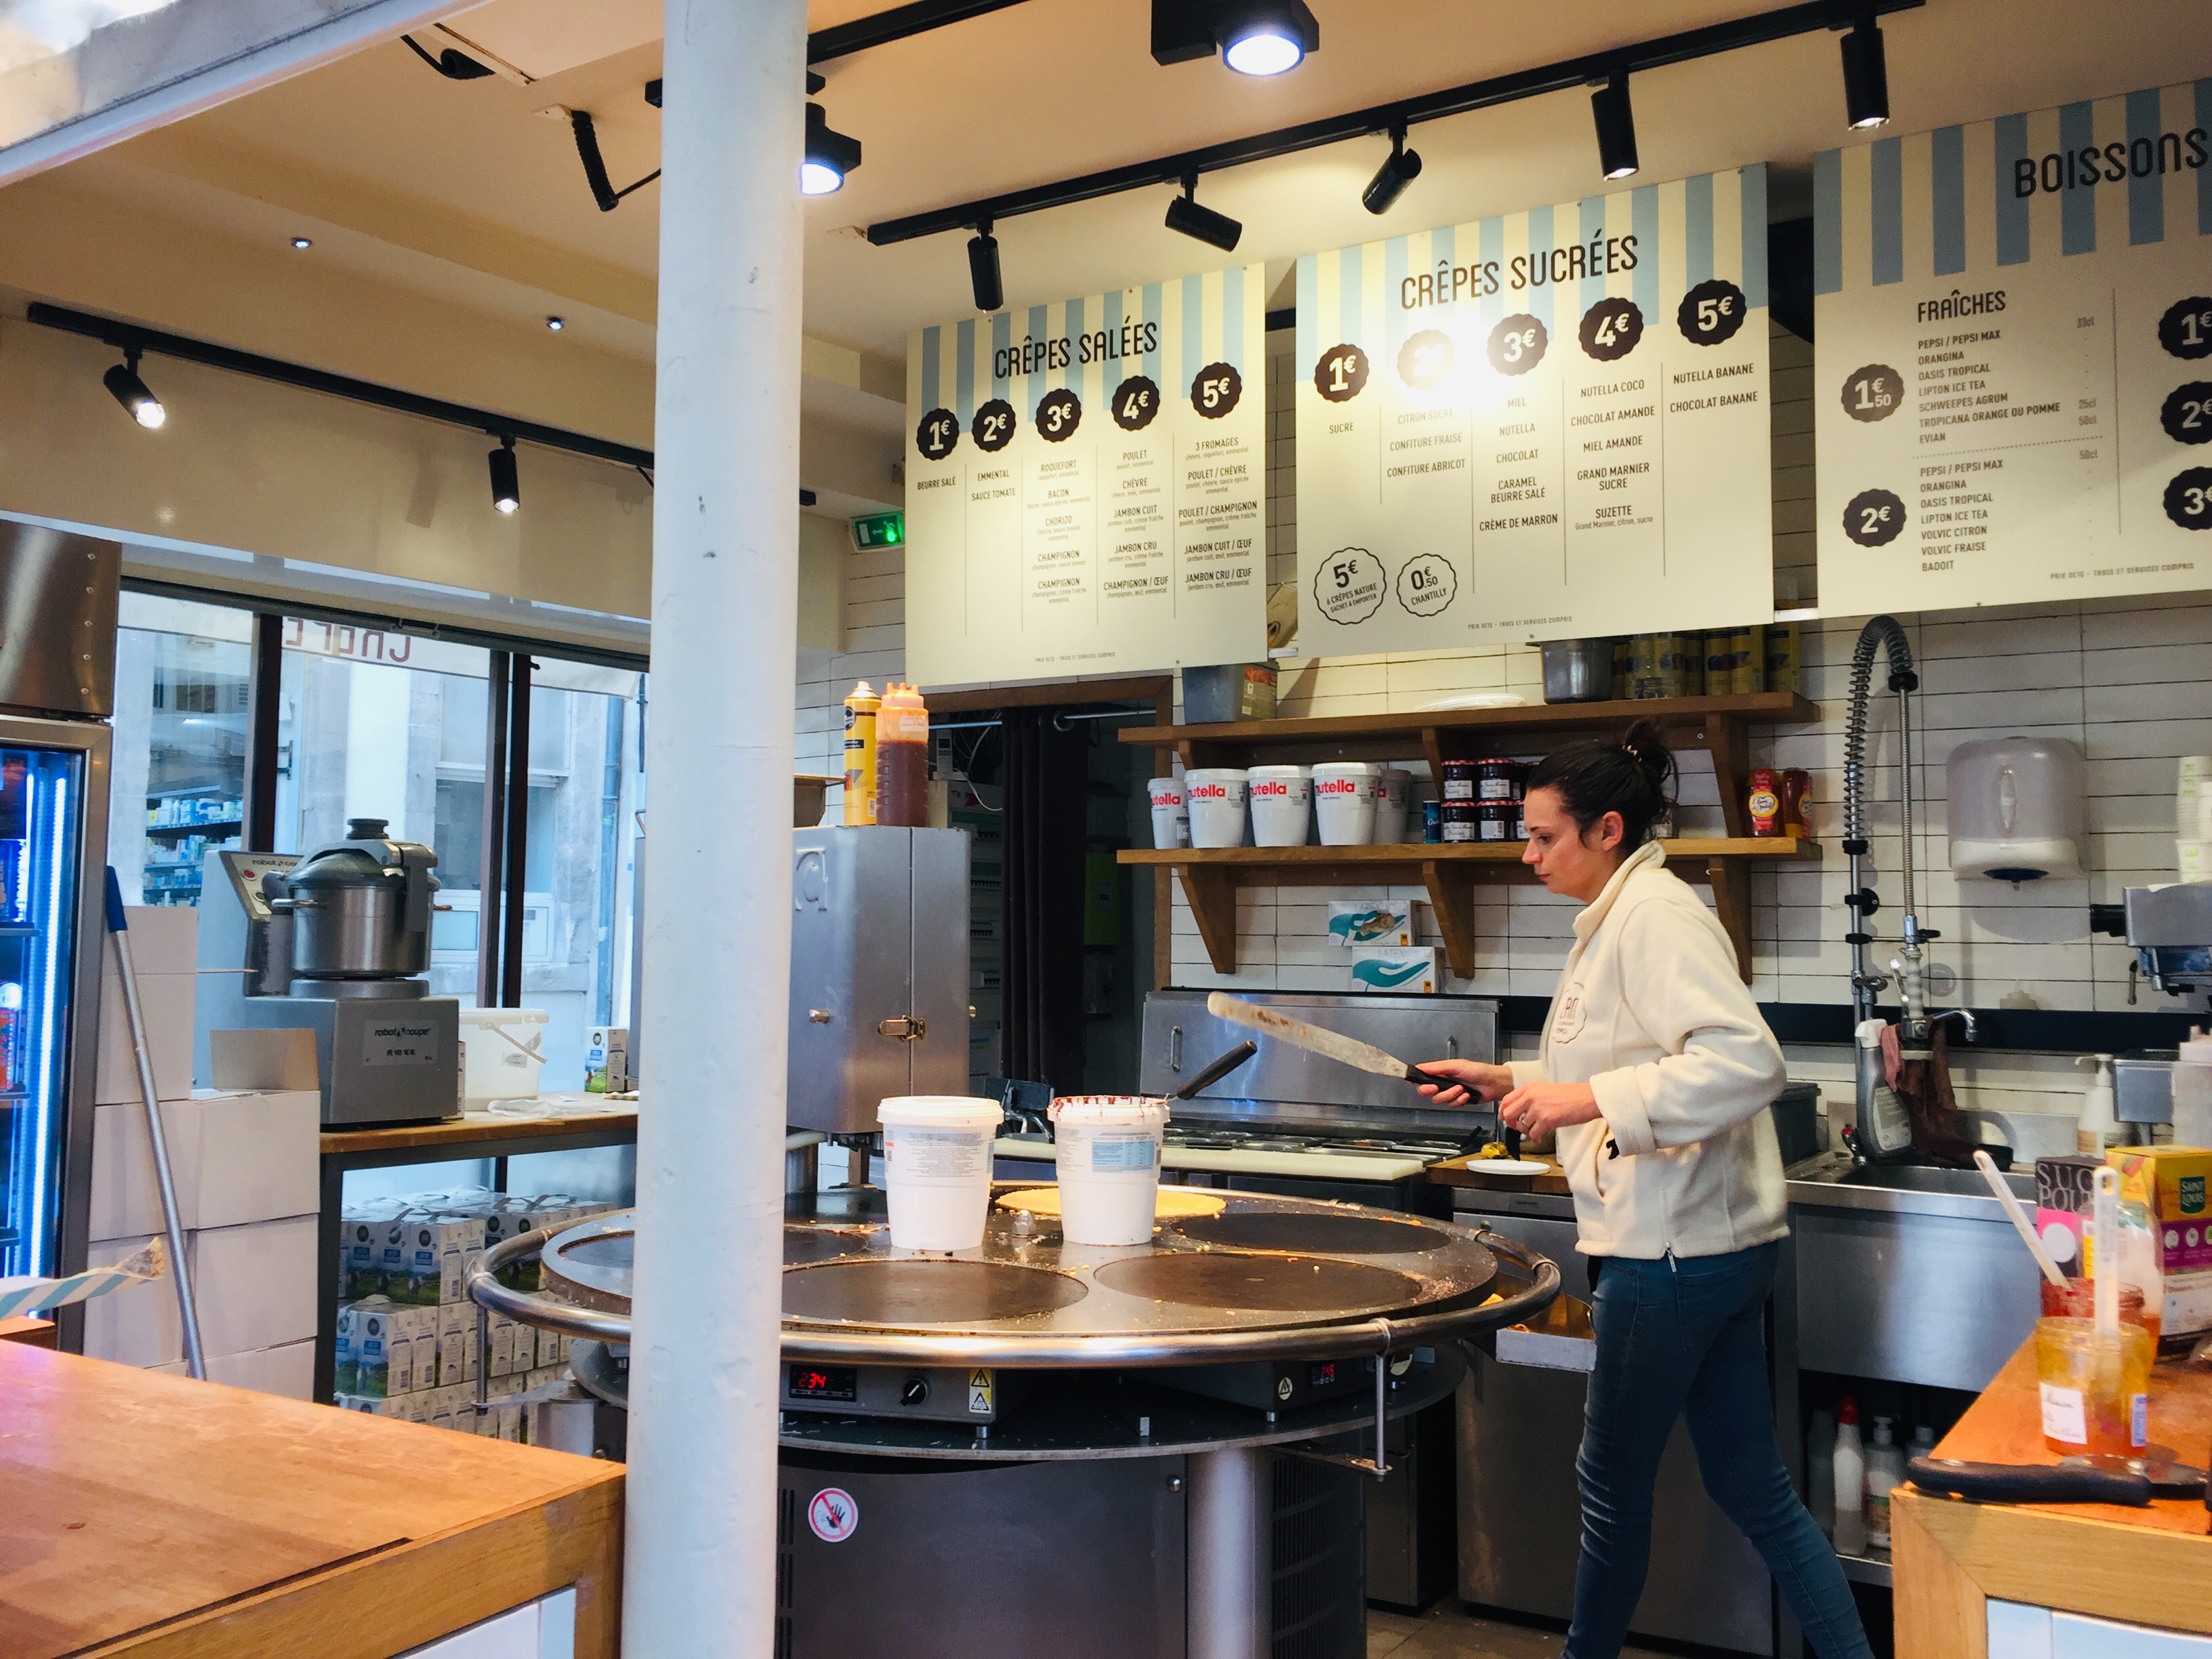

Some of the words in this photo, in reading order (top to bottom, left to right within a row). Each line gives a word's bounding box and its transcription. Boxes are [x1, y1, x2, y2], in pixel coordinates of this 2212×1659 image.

[1401, 260, 1499, 309] CRÊPES
[1511, 228, 1638, 290] SUCRÉES
[1917, 289, 2007, 323] FRAÎCHES
[1918, 337, 1943, 349] PEPSI
[1952, 333, 1978, 346] PEPSI
[1981, 329, 2001, 341] MAX
[995, 335, 1071, 379] CRÊPES
[1078, 315, 1157, 364] SALÉES
[1918, 350, 1965, 365] ORANGINA
[1673, 369, 1714, 384] NUTELLA
[1716, 363, 1754, 377] BANANE
[1918, 367, 1945, 382] OASIS
[1947, 363, 1991, 377] TROPICAL
[1580, 383, 1618, 398] NUTELLA
[1620, 380, 1644, 392] COCO
[1919, 384, 1950, 397] LIPTON
[1952, 382, 1967, 393] ICE
[1969, 380, 1986, 390] TEA
[1507, 397, 1526, 408] MIEL
[1670, 397, 1717, 413] CHOCOLAT
[1720, 391, 1758, 407] BANANE
[1975, 392, 2008, 407] AGRUM
[1398, 412, 1426, 424] CITRON
[1571, 411, 1615, 427] CHOCOLAT
[1617, 406, 1655, 421] AMANDE
[1919, 413, 1970, 428] TROPICANA
[1972, 409, 2009, 422] ORANGE
[2011, 407, 2024, 417] OU
[2026, 402, 2061, 415] POMME
[1329, 422, 1353, 434] SUCRE
[1499, 423, 1536, 436] NUTELLA
[1196, 443, 1200, 451] 3
[1202, 437, 1238, 450] FROMAGES
[1390, 436, 1432, 451] CONFITURE
[1435, 433, 1462, 445] FRAISE
[1583, 441, 1603, 453] MIEL
[1605, 435, 1643, 449] AMANDE
[1919, 432, 1946, 444] EVIAN
[1123, 450, 1147, 461] POULET
[1496, 449, 1539, 464] CHOCOLAT
[1041, 459, 1077, 472] ROQUEFORT
[1188, 469, 1213, 480] POULET
[1220, 465, 1246, 476] CHÈVRE
[1387, 463, 1430, 477] CONFITURE
[1432, 459, 1465, 472] ABRICOT
[1577, 466, 1607, 480] GRAND
[1610, 462, 1650, 476] MARNIER
[1920, 466, 1946, 477] PEPSI
[1954, 462, 1982, 474] PEPSI
[1983, 459, 2003, 470] MAX
[918, 479, 940, 490] BEURRE
[941, 476, 956, 487] SALÉ
[977, 470, 1009, 481] EMMENTAL
[1122, 478, 1148, 489] CHÈVRE
[1498, 476, 1537, 491] CARAMEL
[1599, 478, 1628, 491] SUCRE
[1920, 479, 1967, 493] ORANGINA
[972, 490, 991, 501] SAUCE
[993, 487, 1015, 498] TOMATE
[1048, 489, 1069, 499] BACON
[1491, 490, 1523, 504] BEURRE
[1525, 485, 1546, 499] SALÉ
[1921, 496, 1948, 509] OASIS
[1950, 493, 1994, 506] TROPICAL
[1113, 506, 1141, 518] JAMBON
[1142, 505, 1157, 514] CUIT
[1179, 507, 1203, 518] POULET
[1210, 501, 1257, 514] CHAMPIGNON
[1595, 505, 1632, 519] SUZETTE
[1921, 512, 1952, 524] LIPTON
[1954, 511, 1969, 521] ICE
[1971, 509, 1988, 519] TEA
[1045, 516, 1072, 527] CHORIZO
[1479, 517, 1507, 531] CRÈME
[1509, 517, 1519, 529] DE
[1521, 514, 1558, 527] MARRON
[1921, 528, 1952, 540] VOLVIC
[1954, 525, 1987, 537] CITRON
[1114, 543, 1141, 554] JAMBON
[1144, 541, 1157, 550] CRU
[1184, 544, 1212, 554] JAMBON
[1214, 541, 1230, 551] CUIT
[1237, 539, 1252, 548] ŒUF
[1921, 544, 1952, 556] VOLVIC
[1954, 541, 1986, 552] FRAISE
[1038, 550, 1080, 562] CHAMPIGNON
[1921, 560, 1954, 572] BADOIT
[1185, 572, 1214, 583] JAMBON
[1216, 570, 1229, 579] CRU
[1236, 568, 1252, 577] ŒUF
[1038, 577, 1080, 590] CHAMPIGNON
[1104, 579, 1147, 590] CHAMPIGNON
[1331, 590, 1353, 604] CRÊPES
[1355, 583, 1377, 596] NATURE
[1411, 588, 1447, 605] CHANTILLY
[1188, 784, 1226, 798] utella
[1250, 781, 1287, 796] utella
[1315, 779, 1355, 795] utella
[2036, 1162, 2094, 1193] SUC
